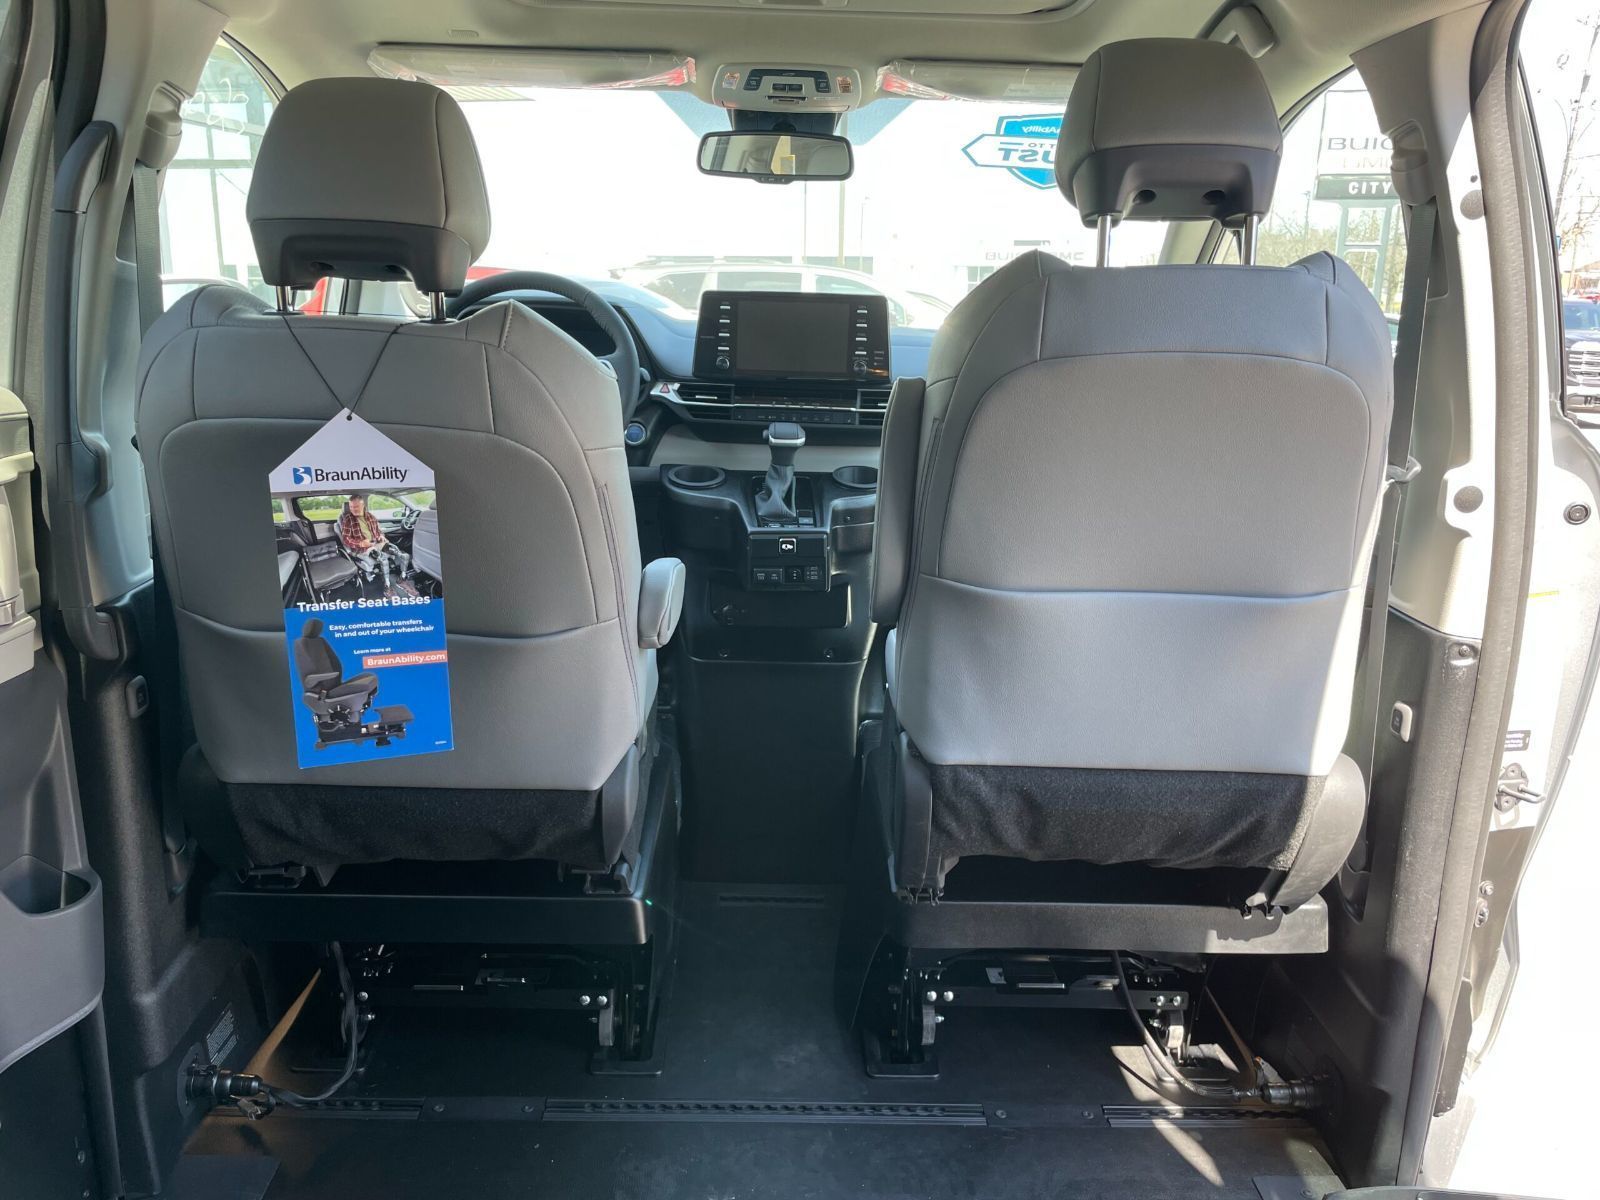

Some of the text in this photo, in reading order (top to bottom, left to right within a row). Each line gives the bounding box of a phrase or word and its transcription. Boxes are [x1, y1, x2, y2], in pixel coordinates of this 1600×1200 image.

[1327, 137, 1394, 150] BUIC
[1348, 181, 1393, 195] CITY
[314, 466, 408, 483] BraunAbility
[296, 595, 431, 613] Transfer Seat Bases
[348, 620, 391, 630] comfortable
[392, 619, 423, 627] transfers
[357, 629, 370, 637] out
[379, 628, 395, 636] your
[396, 625, 435, 634] wheelchair
[367, 651, 446, 667] BraunAbility.com
